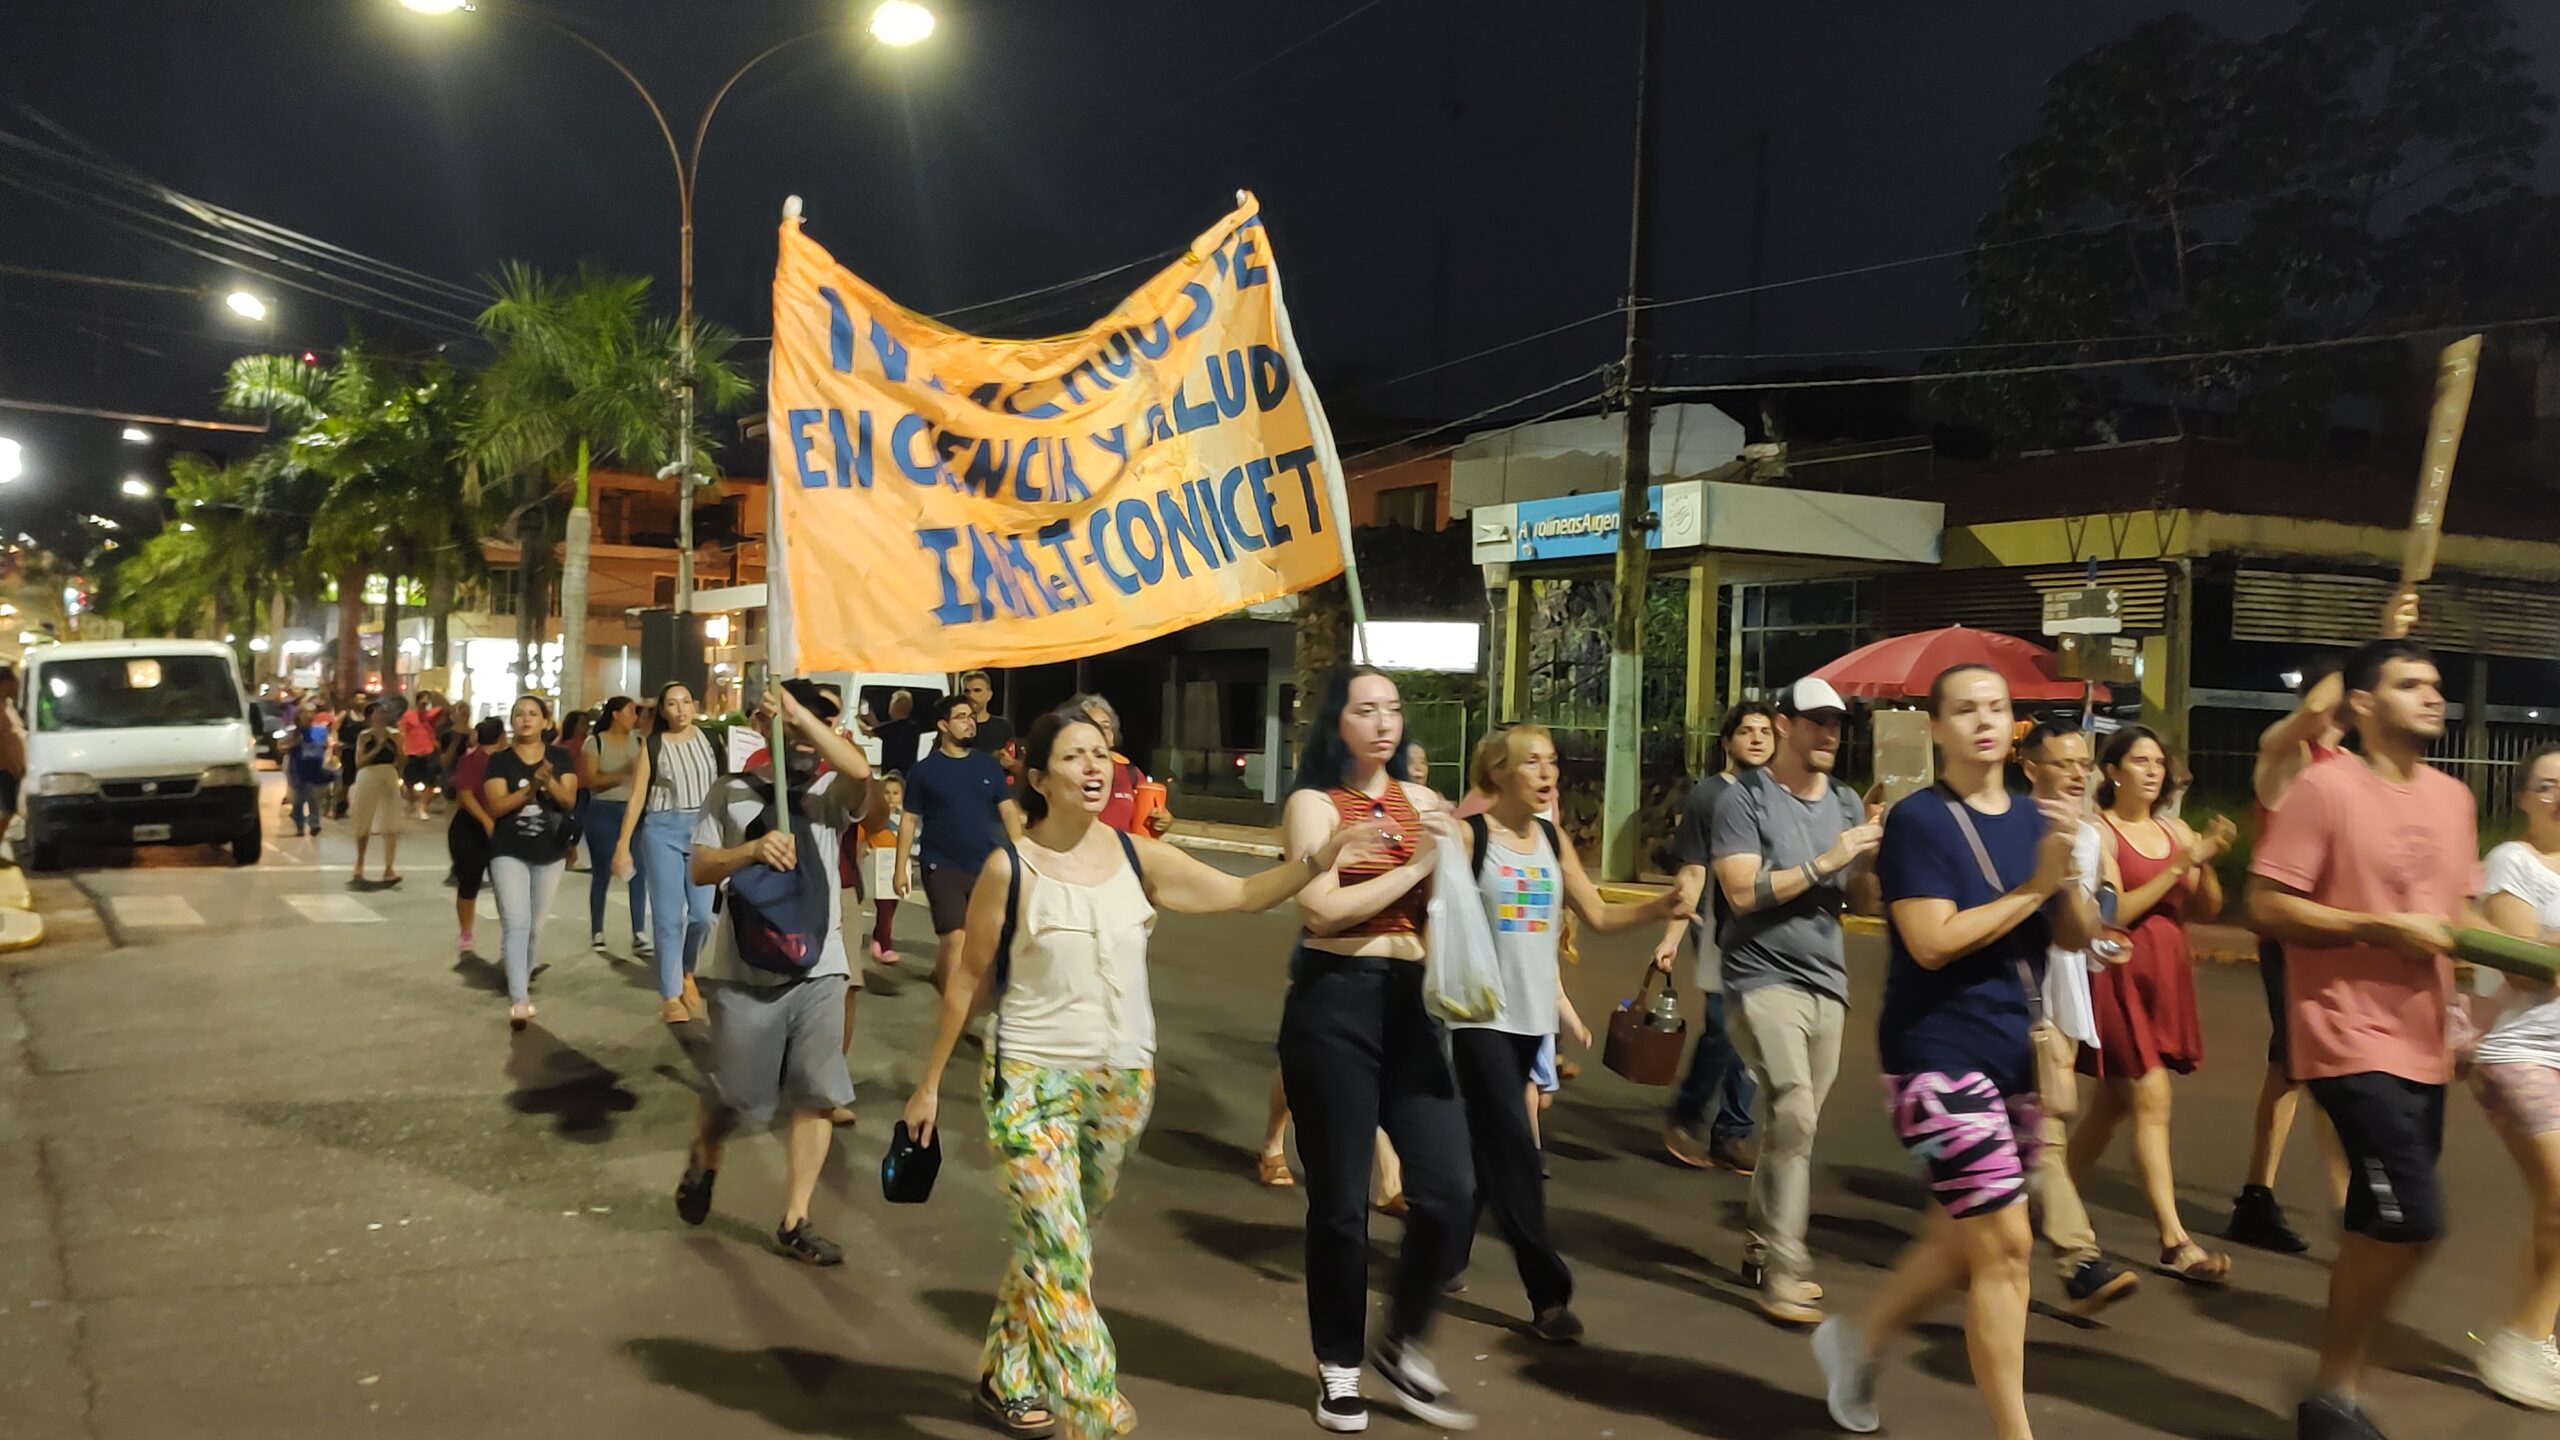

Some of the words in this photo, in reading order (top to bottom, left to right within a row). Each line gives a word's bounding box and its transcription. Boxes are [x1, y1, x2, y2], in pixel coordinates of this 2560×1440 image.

[788, 409, 873, 488] EN
[891, 413, 1093, 503] CENCIA
[1091, 424, 1128, 463] Y
[1146, 344, 1290, 447] ALUD
